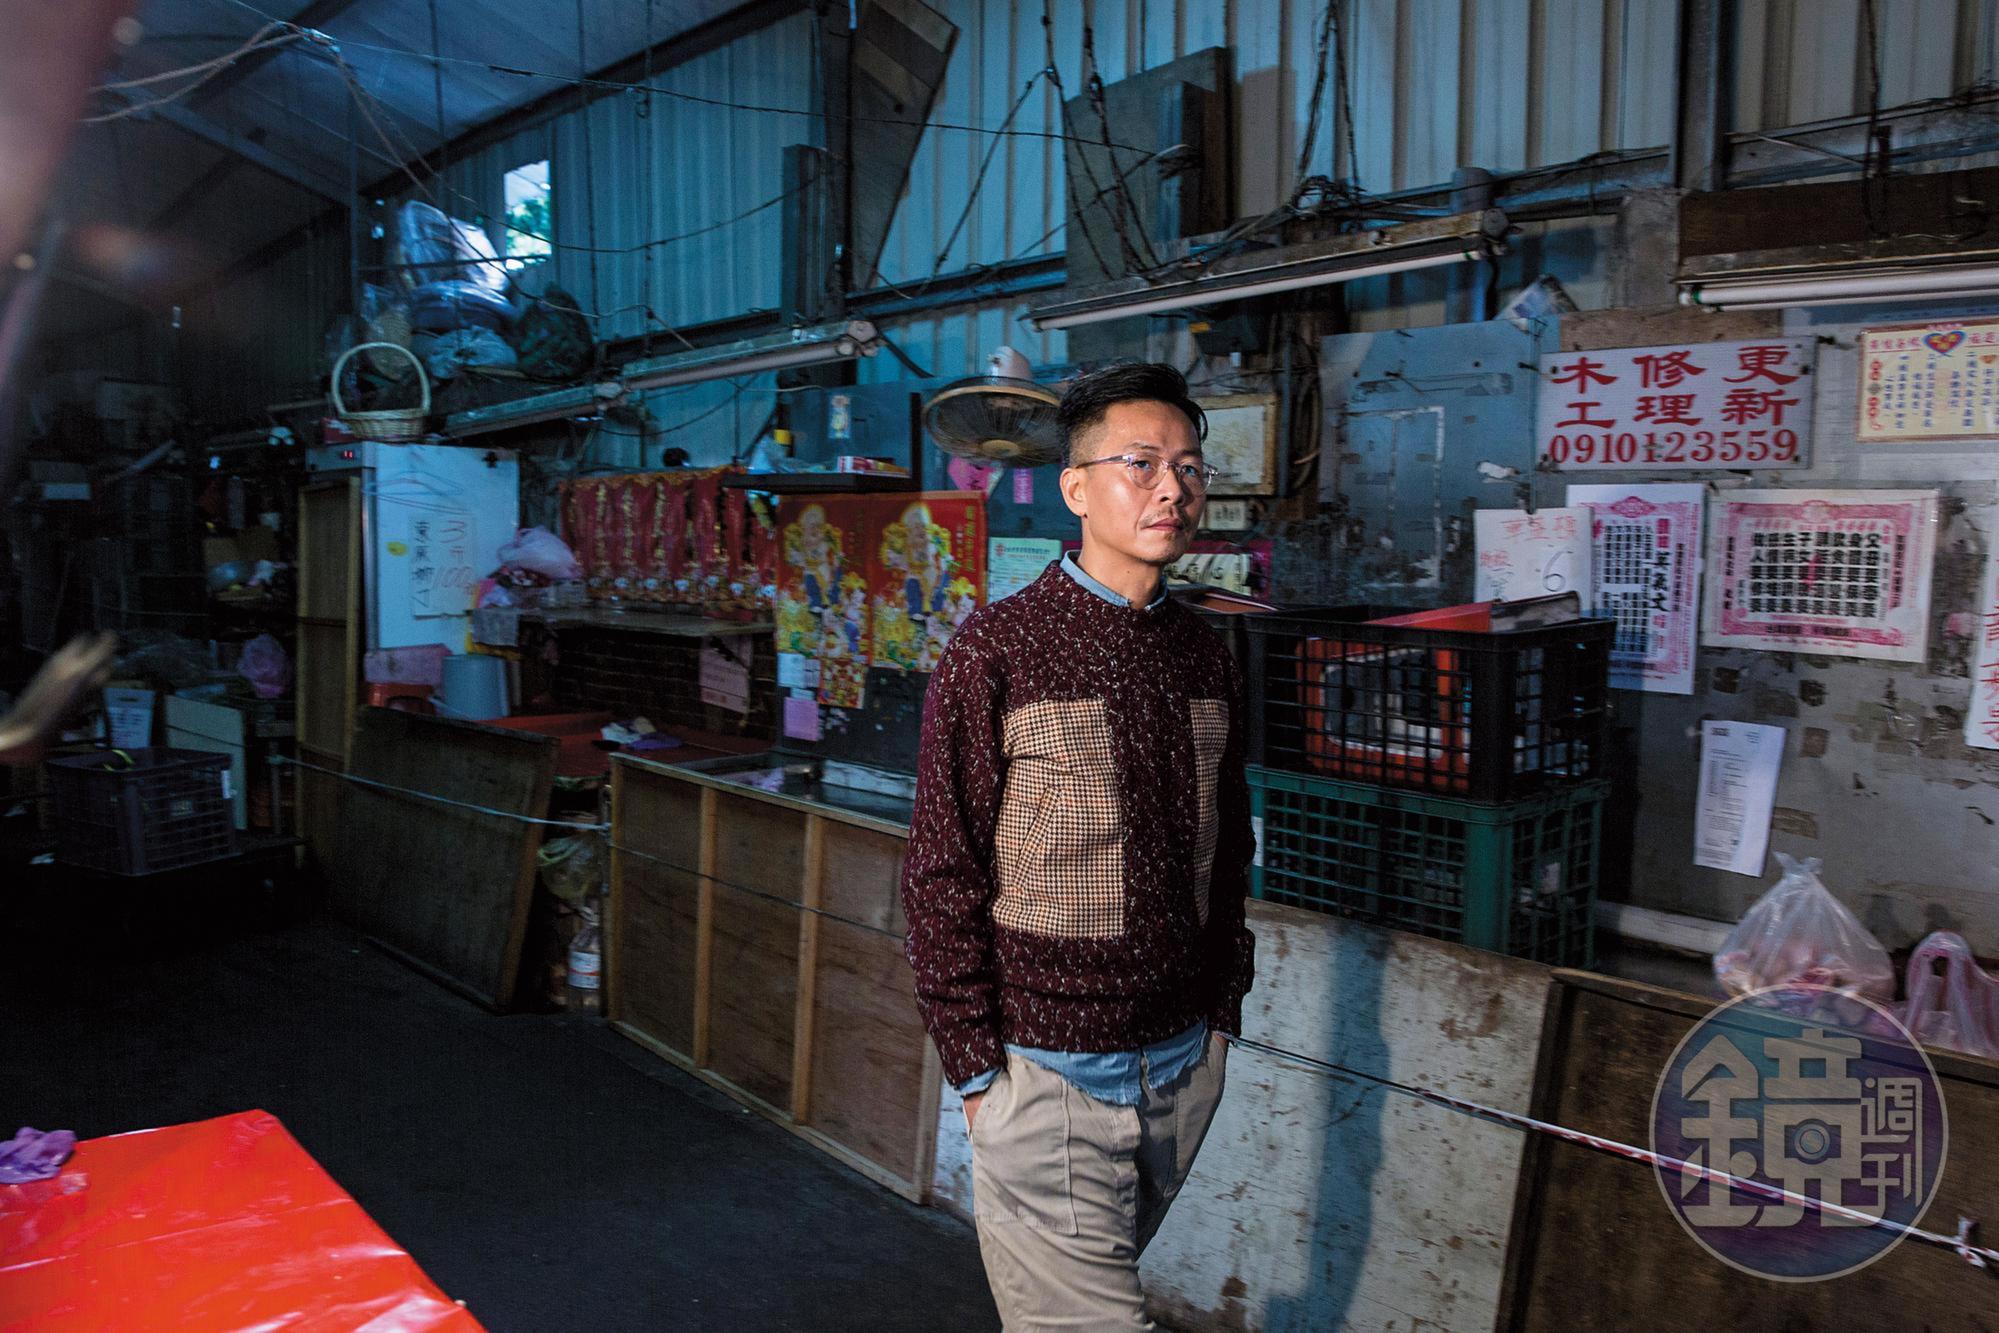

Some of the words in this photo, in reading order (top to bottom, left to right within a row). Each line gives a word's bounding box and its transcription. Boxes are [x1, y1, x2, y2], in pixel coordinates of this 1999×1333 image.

[1552, 356, 1619, 428] 木工
[1632, 350, 1707, 426] 修理
[1721, 345, 1800, 426] 更新
[1549, 429, 1798, 463] 0910123559
